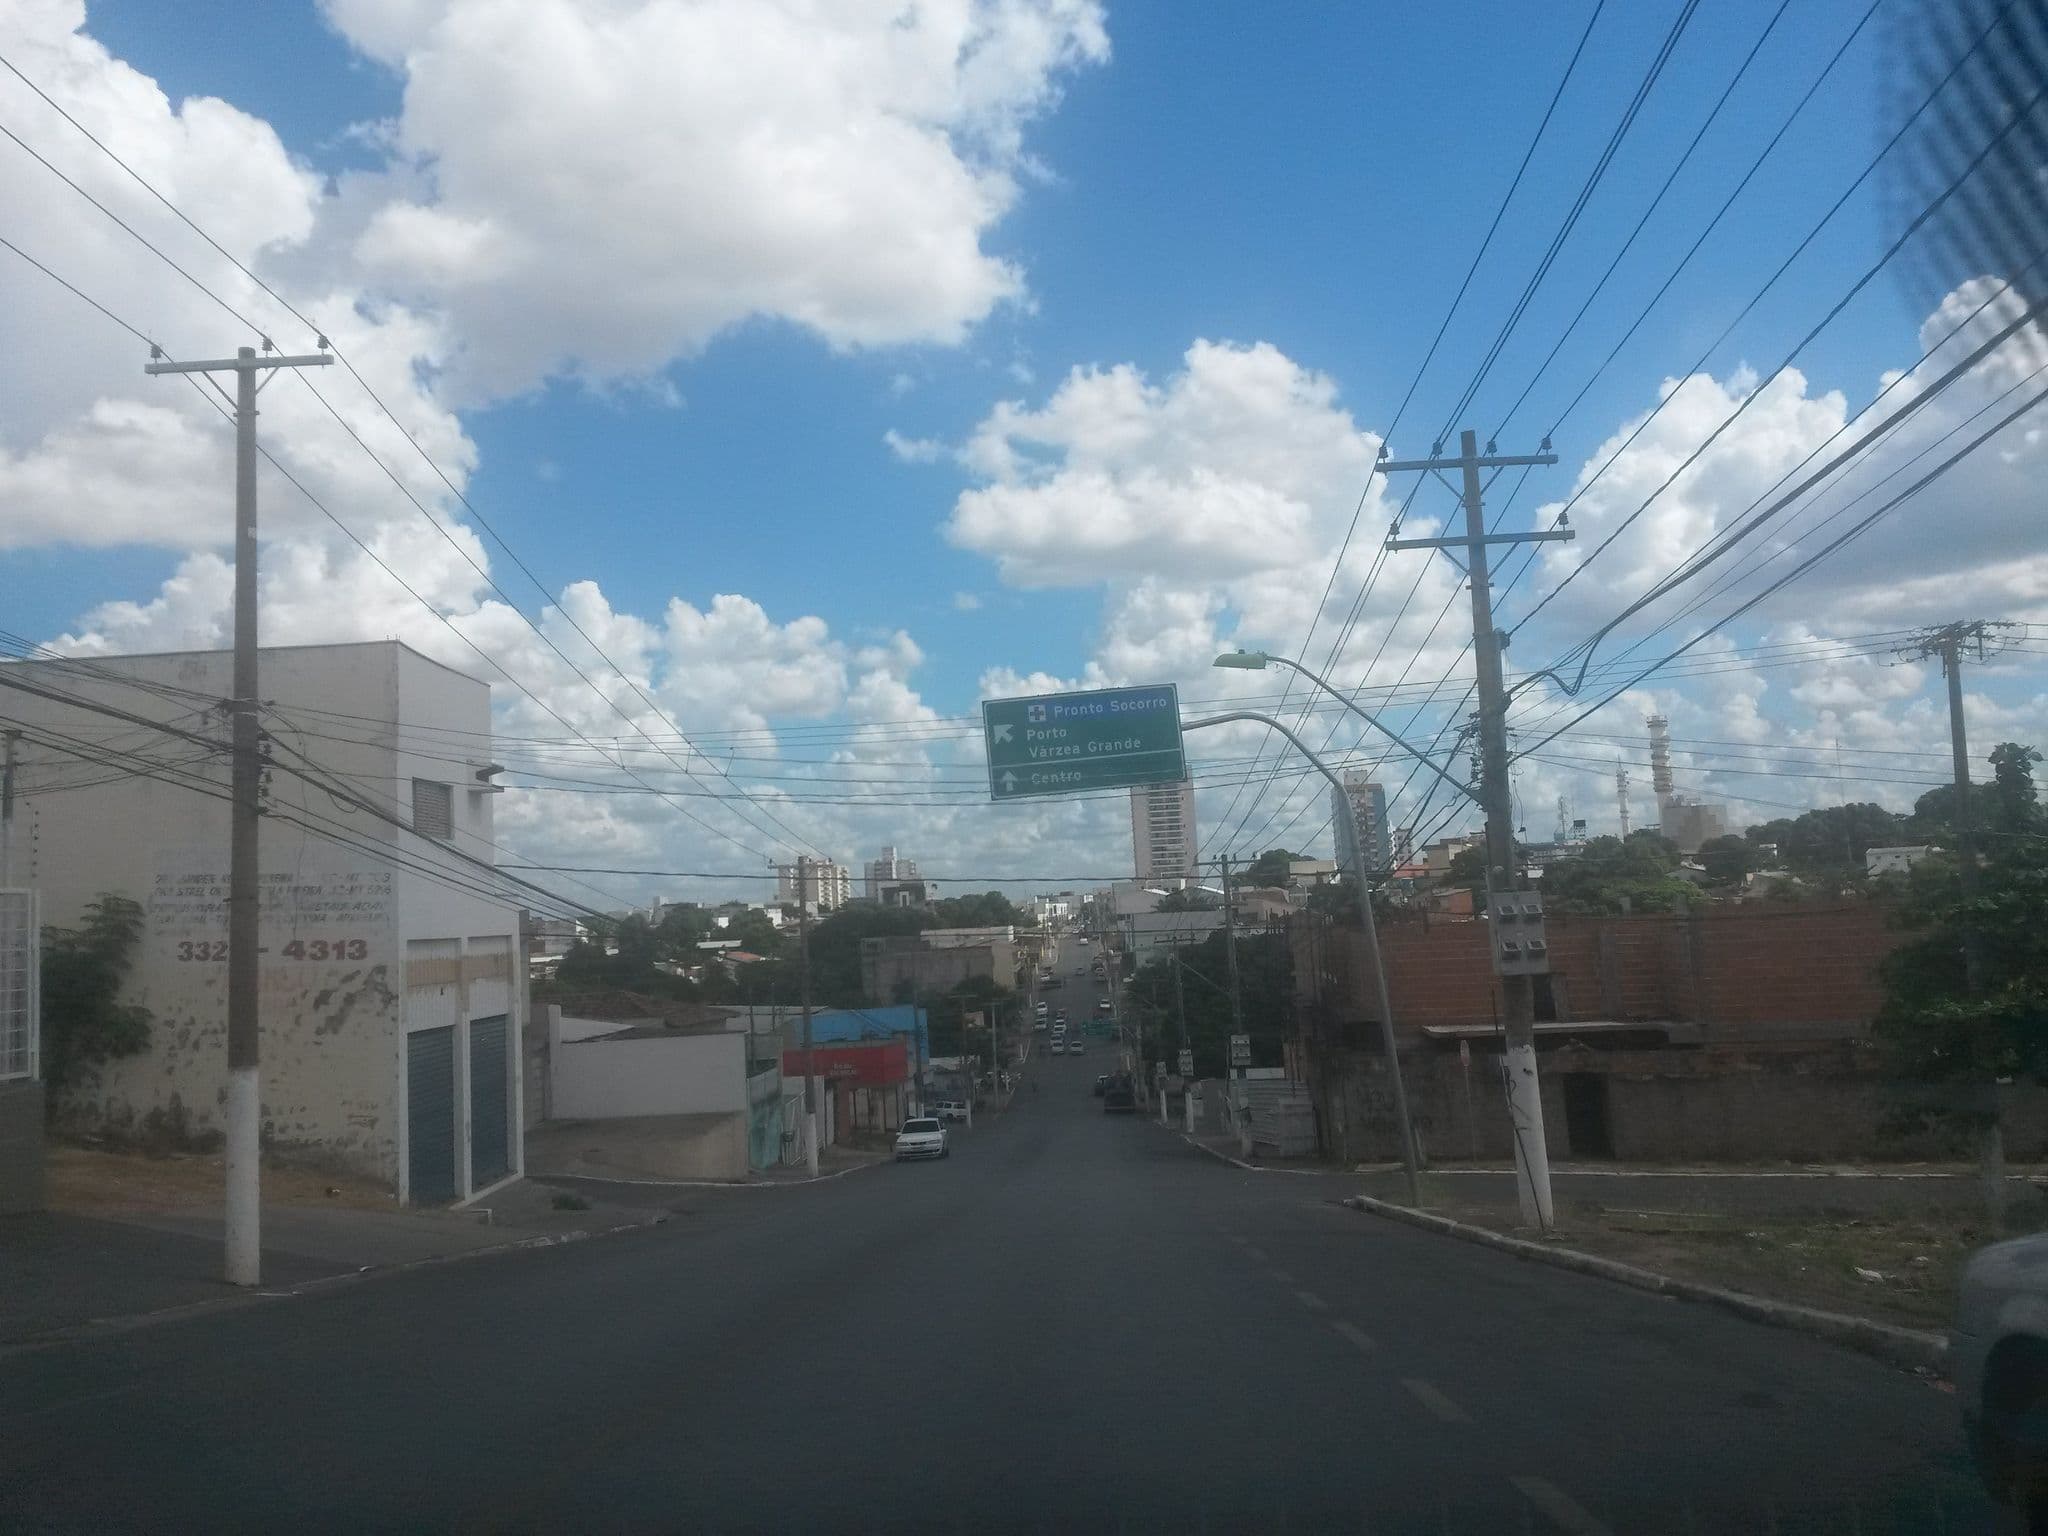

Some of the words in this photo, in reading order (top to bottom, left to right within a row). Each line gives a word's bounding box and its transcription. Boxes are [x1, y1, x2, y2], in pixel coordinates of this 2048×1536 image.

[1054, 704, 1104, 718] Pronto
[1110, 697, 1167, 712] Socorro
[1026, 727, 1068, 741] Porto
[1088, 737, 1141, 753] Grande
[1031, 770, 1082, 785] Centro
[177, 940, 231, 961] 332
[281, 939, 368, 961] 4313
